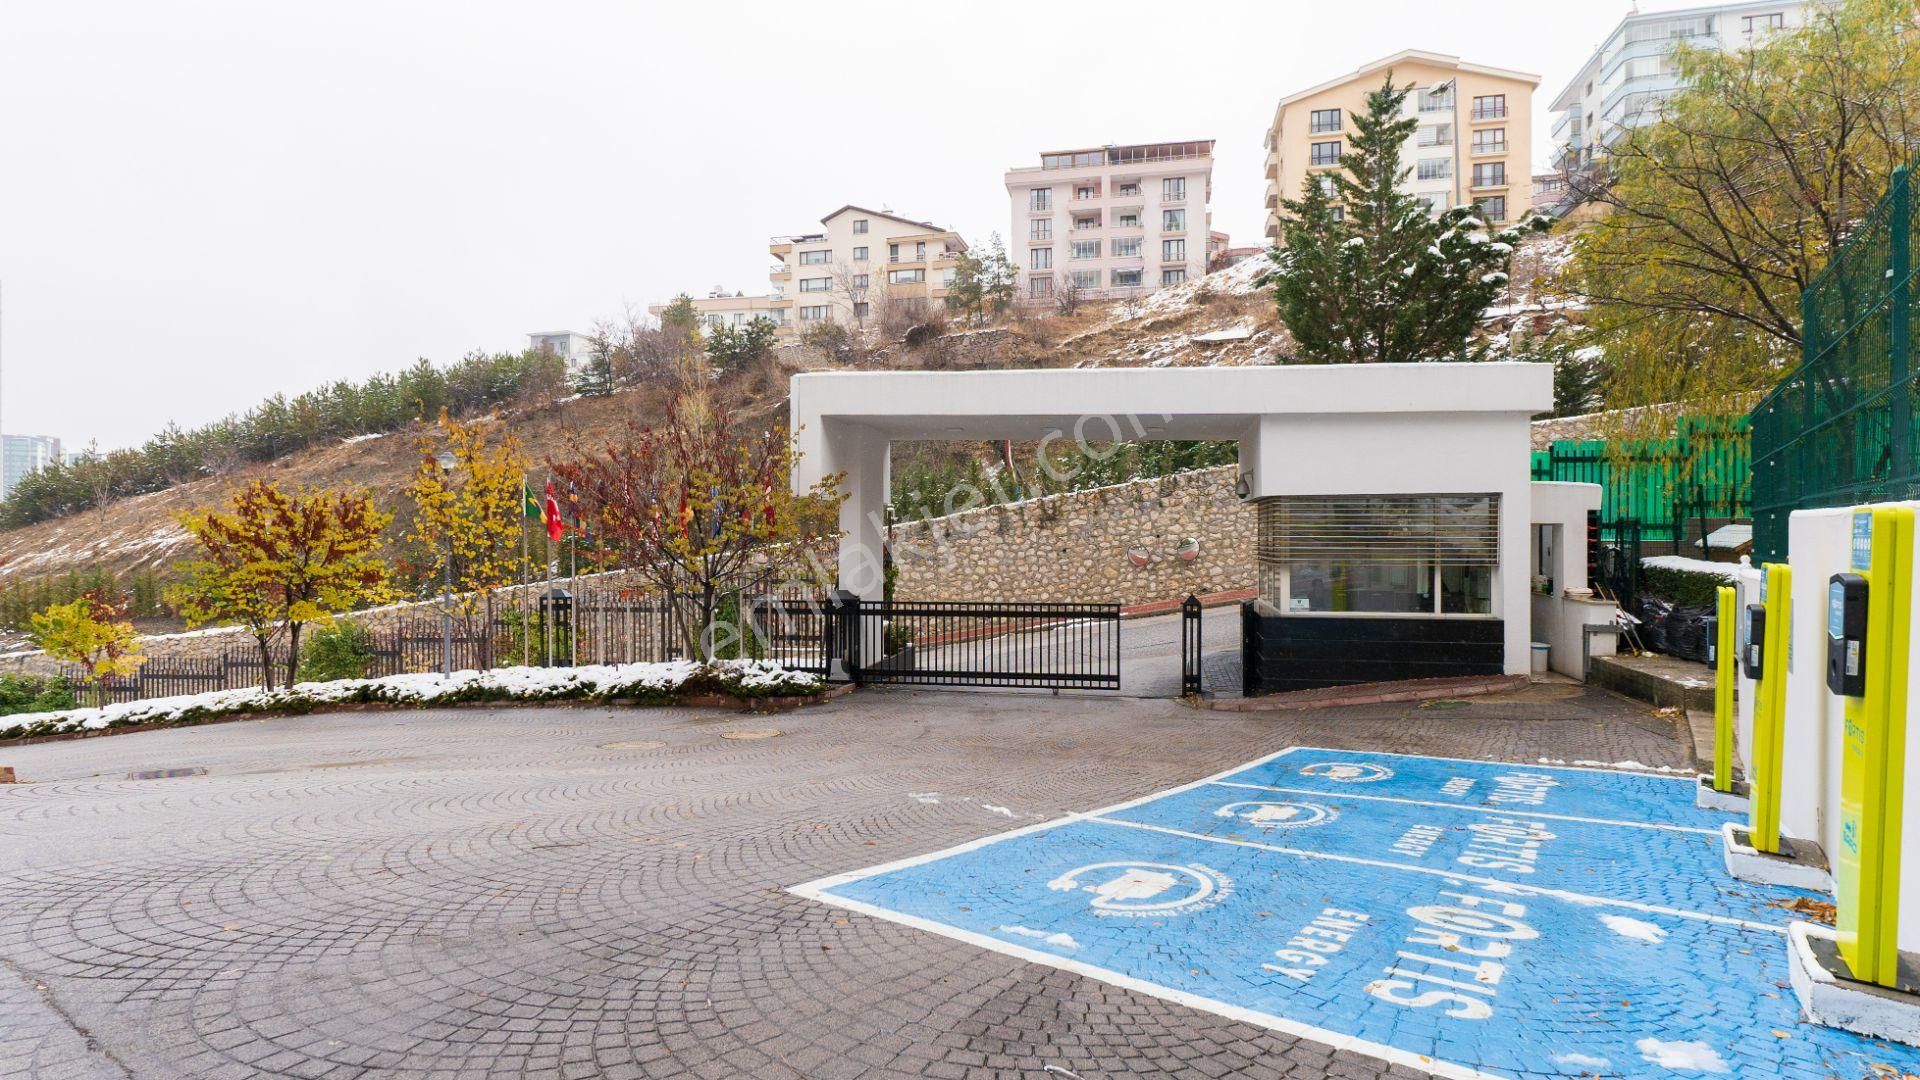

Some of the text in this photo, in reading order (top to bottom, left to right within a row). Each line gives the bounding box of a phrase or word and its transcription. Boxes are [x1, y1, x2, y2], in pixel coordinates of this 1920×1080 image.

[1388, 824, 1444, 857] ENERGY
[1457, 814, 1558, 874] FORTIS
[1261, 907, 1371, 982] ENERGY
[1364, 891, 1540, 1019] FORTIS
